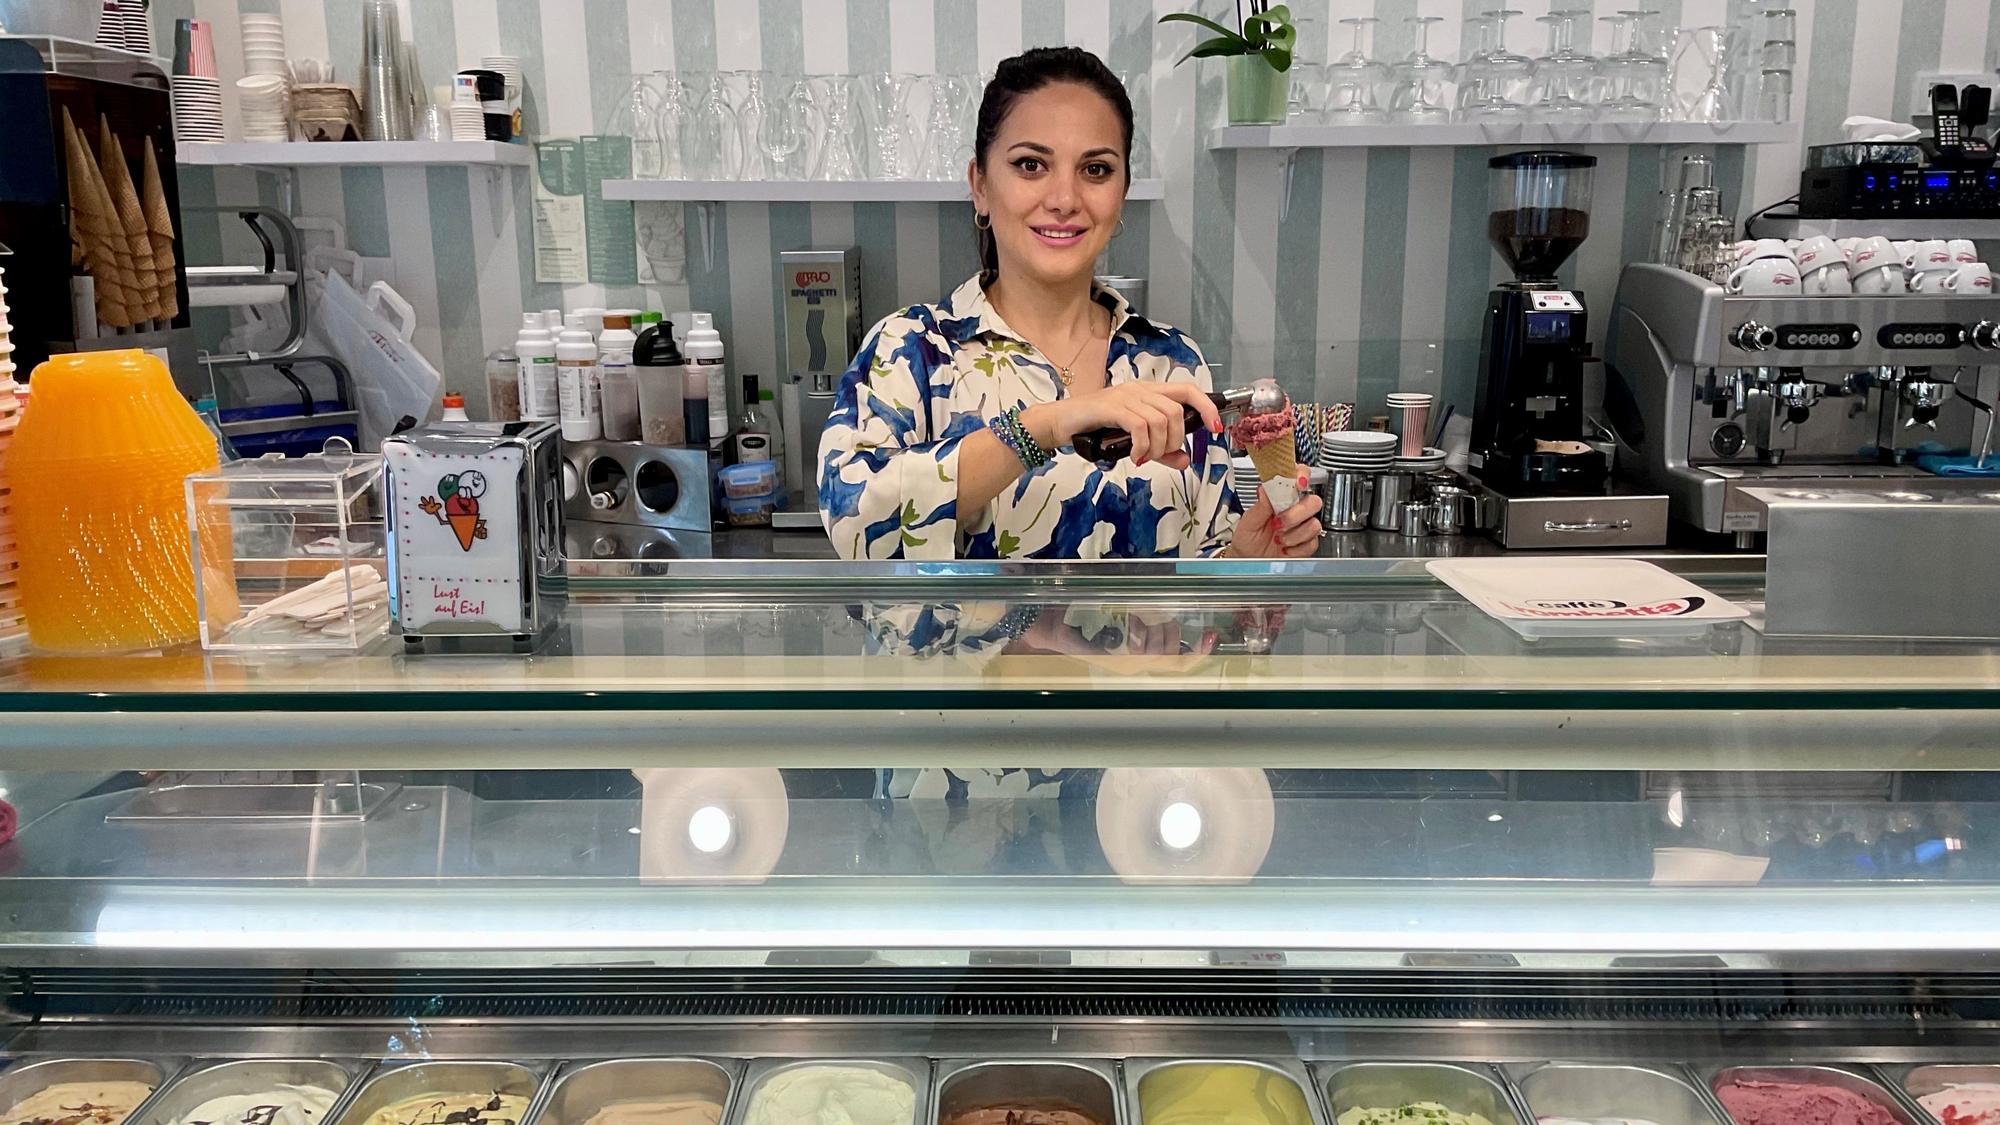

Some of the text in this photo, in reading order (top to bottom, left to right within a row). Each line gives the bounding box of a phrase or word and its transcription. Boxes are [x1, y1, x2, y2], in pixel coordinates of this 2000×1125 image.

[434, 584, 461, 599] Lust
[435, 600, 485, 618] auf Eis!
